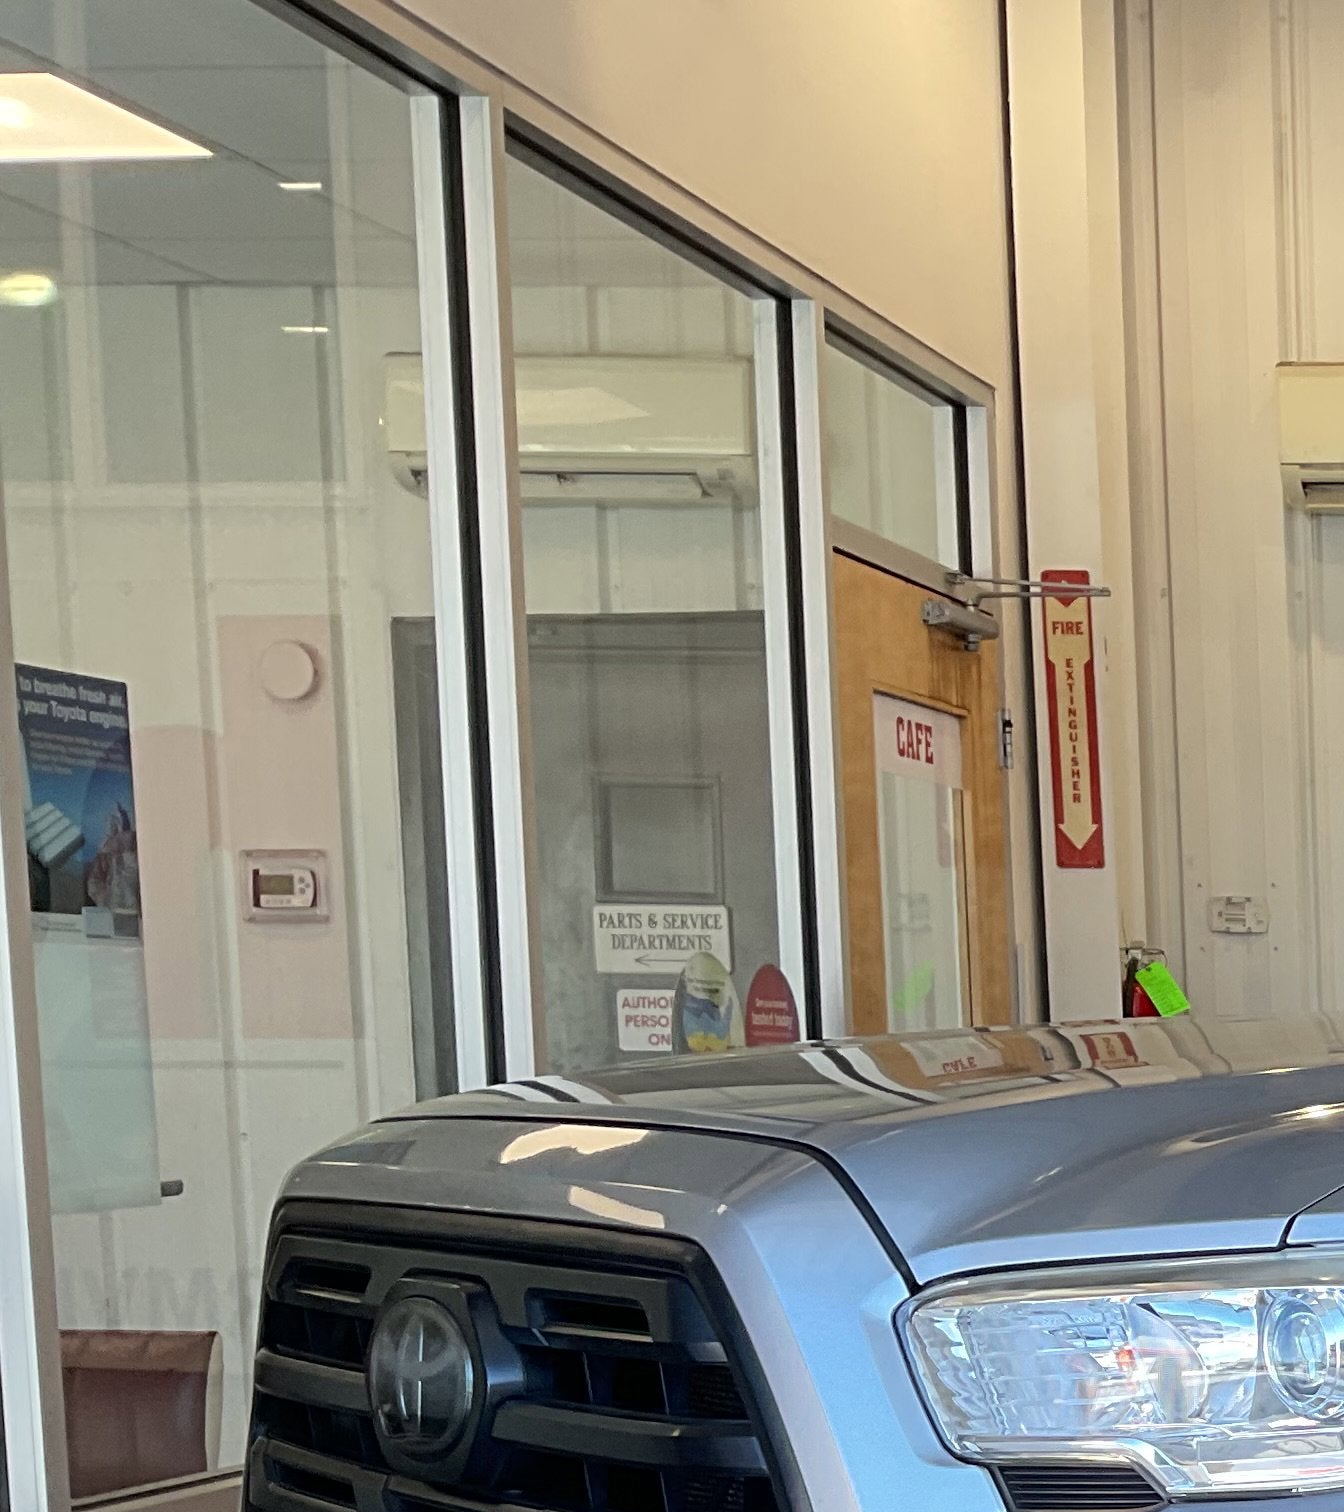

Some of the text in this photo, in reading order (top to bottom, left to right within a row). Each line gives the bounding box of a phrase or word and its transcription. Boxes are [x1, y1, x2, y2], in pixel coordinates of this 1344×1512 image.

[1052, 620, 1084, 636] FIRE
[50, 700, 88, 722] Toyota
[1065, 657, 1081, 804] EXTINGUISHER
[896, 715, 934, 765] CAFE
[599, 912, 723, 930] PARTS & SERVICE
[611, 933, 713, 951] DEPARTMENTS
[624, 1014, 672, 1028] PERSO
